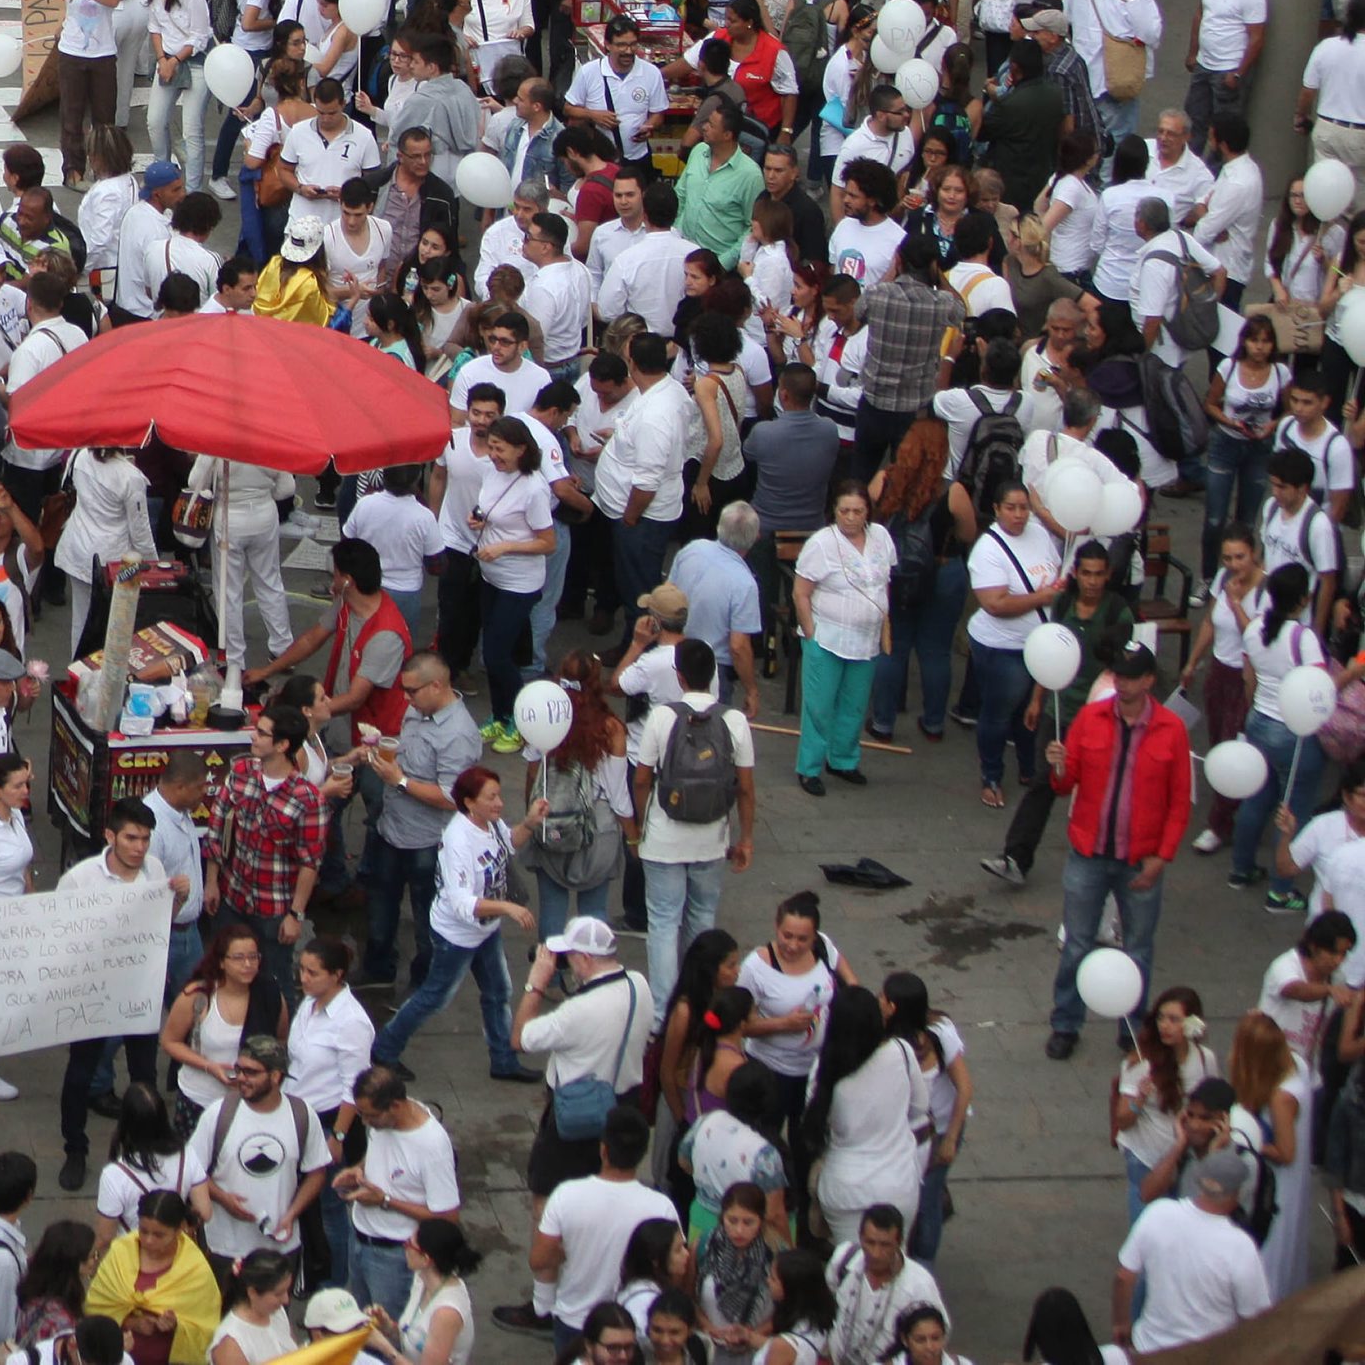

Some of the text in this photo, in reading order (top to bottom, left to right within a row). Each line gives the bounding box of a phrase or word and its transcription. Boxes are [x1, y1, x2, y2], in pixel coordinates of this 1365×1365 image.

[341, 144, 350, 159] 1
[521, 707, 536, 723] LA
[118, 749, 224, 769] CERVA
[38, 898, 57, 913] YA
[63, 893, 113, 911] TIENES
[120, 890, 137, 905] LO
[51, 917, 108, 938] SANTOS
[39, 943, 58, 958] LO
[65, 939, 95, 955] QUE
[4, 992, 38, 1008] QUE
